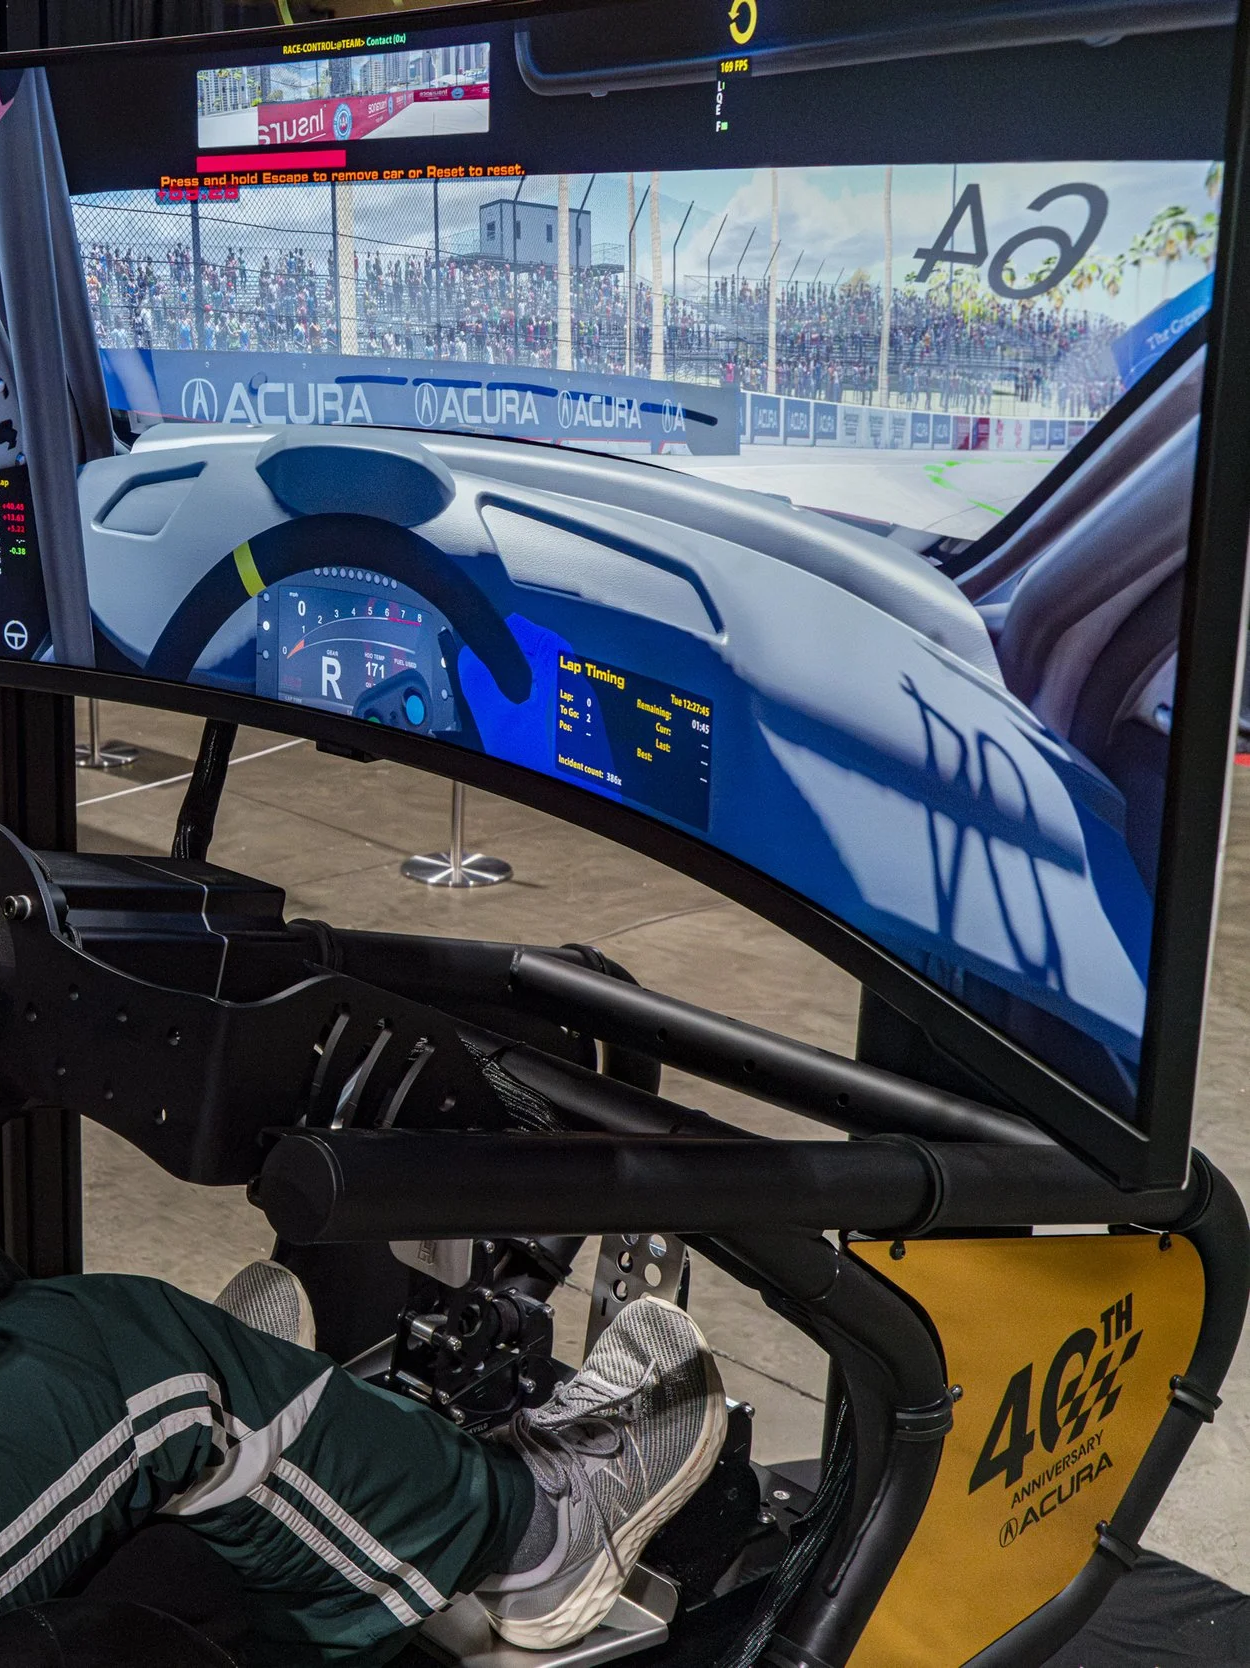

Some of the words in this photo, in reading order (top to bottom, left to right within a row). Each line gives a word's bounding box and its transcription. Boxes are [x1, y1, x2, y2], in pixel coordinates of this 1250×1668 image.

[366, 36, 392, 46] Contact
[393, 33, 406, 45] (0x)
[721, 62, 733, 73] 169
[734, 59, 748, 71] FPS
[160, 176, 199, 187] Press
[204, 174, 227, 185] and
[231, 173, 258, 185] hold
[262, 171, 309, 184] Escape
[313, 171, 327, 182] to
[331, 170, 378, 181] remove
[383, 170, 403, 180] car
[408, 169, 423, 179] or
[426, 165, 465, 178] Reset
[469, 165, 483, 176] to
[487, 163, 526, 176] reset.
[222, 382, 374, 424] ACURA
[441, 388, 540, 425] ACURA
[573, 396, 642, 429] ACURA
[9, 547, 26, 555] -0.38
[297, 600, 306, 617] 0
[334, 609, 340, 618] 3
[351, 607, 356, 616] 4
[367, 606, 373, 616] 5
[384, 607, 390, 617] 6
[400, 609, 406, 618] 7
[317, 615, 323, 624] 2
[417, 613, 423, 623] 8
[301, 625, 306, 633] 1
[282, 646, 288, 655] 0
[321, 655, 343, 700] R
[365, 661, 385, 679] 171
[560, 655, 582, 674] Lap
[585, 662, 625, 690] Timing
[560, 689, 574, 702] Lap:
[586, 697, 592, 708] 0
[670, 693, 682, 707] Tue
[683, 699, 710, 717] 12:27:45
[560, 704, 568, 715] To
[568, 707, 579, 719] Go:
[586, 713, 591, 723] 2
[636, 698, 672, 721] Remaining:
[691, 719, 710, 735] 01:45
[559, 719, 573, 732] Pos:
[655, 722, 671, 736] Curr:
[655, 738, 671, 753] Last:
[636, 747, 653, 762] Best:
[558, 753, 584, 771] Incident
[584, 765, 604, 779] count:
[1011, 1429, 1104, 1509] ANNIVERSARY
[1018, 1451, 1114, 1536] ACURA
